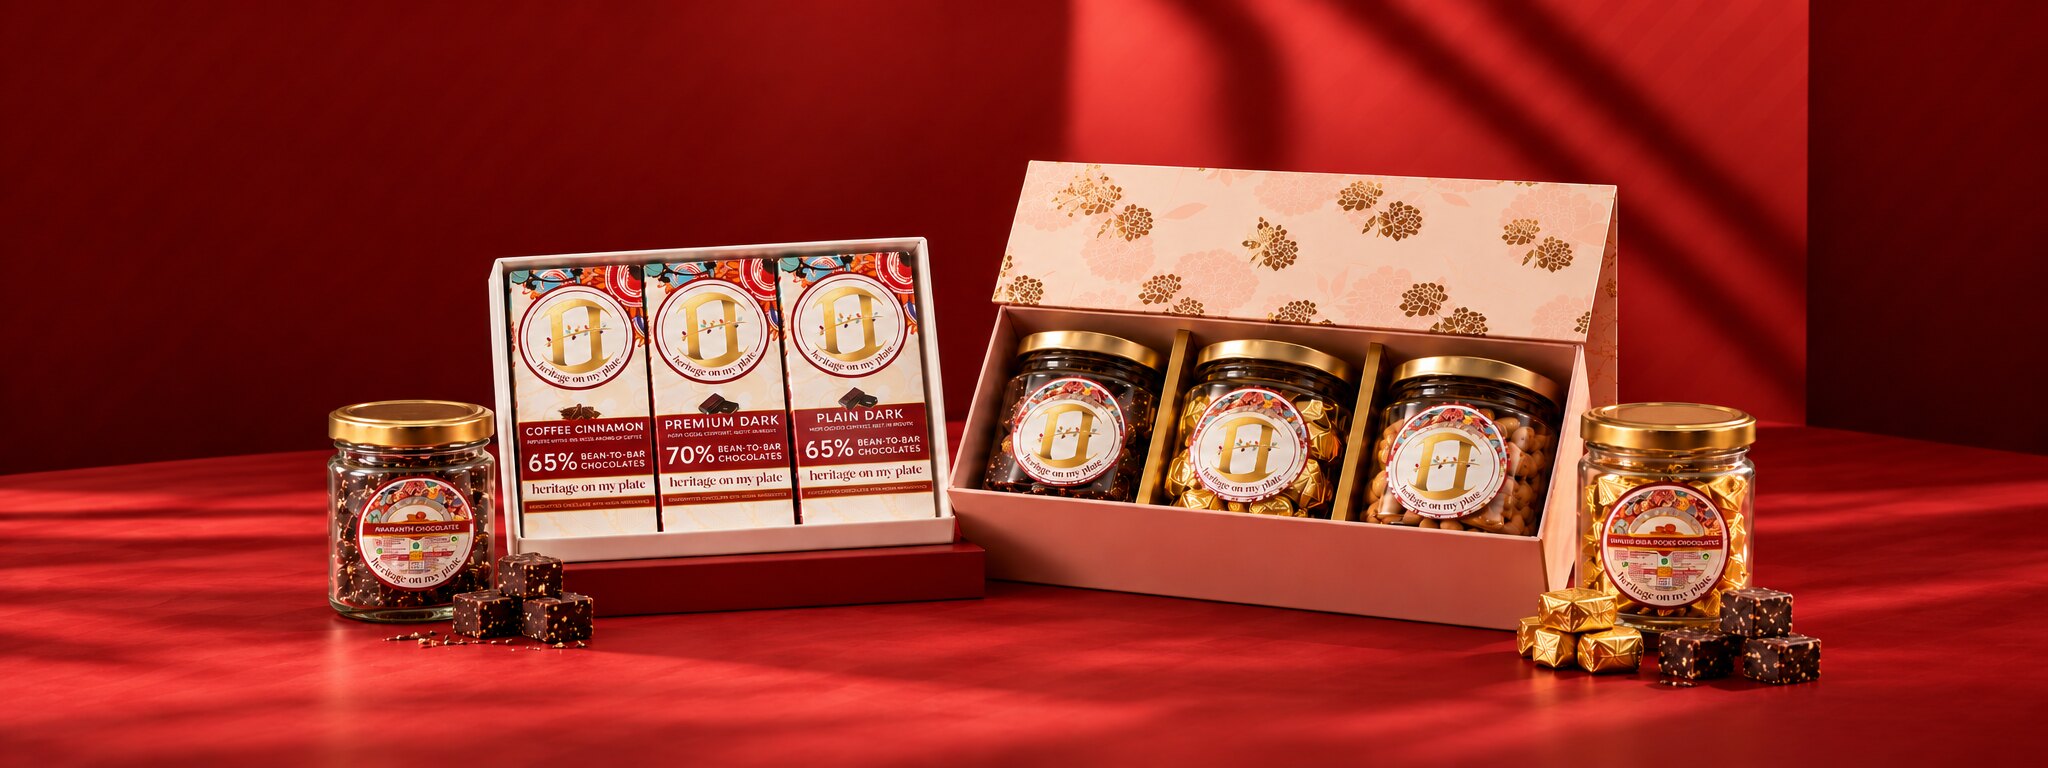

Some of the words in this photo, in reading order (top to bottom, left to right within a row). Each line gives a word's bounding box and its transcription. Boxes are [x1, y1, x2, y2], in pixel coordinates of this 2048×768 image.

[723, 367, 735, 375] my
[861, 361, 874, 369] my
[665, 417, 734, 429] PREMIUM
[740, 415, 779, 426] DARK
[817, 411, 858, 423] PLAIN
[865, 409, 903, 420] DARK
[526, 426, 571, 436] COFFEE
[575, 422, 643, 434] CINNAMON
[858, 436, 920, 446] BEAN-TO-BAR
[718, 443, 781, 453] BEAN-TO-BAR
[806, 439, 853, 459] 65%
[858, 445, 920, 455] CHOCOLATES
[581, 450, 645, 460] BEAN-TO-BAR
[666, 445, 714, 465] 70%
[718, 453, 782, 462] CHOCOLATES
[529, 452, 577, 472] 65%
[581, 460, 645, 469] CHOCOLATES
[810, 470, 855, 482] heritage
[876, 469, 891, 478] my
[896, 465, 922, 478] plate
[670, 476, 716, 488] heritage
[719, 477, 733, 485] on
[737, 476, 752, 486] my
[756, 472, 782, 486] plate
[532, 484, 578, 495] heritage
[599, 483, 615, 493] my
[619, 479, 645, 493] plate
[1444, 502, 1457, 511] my
